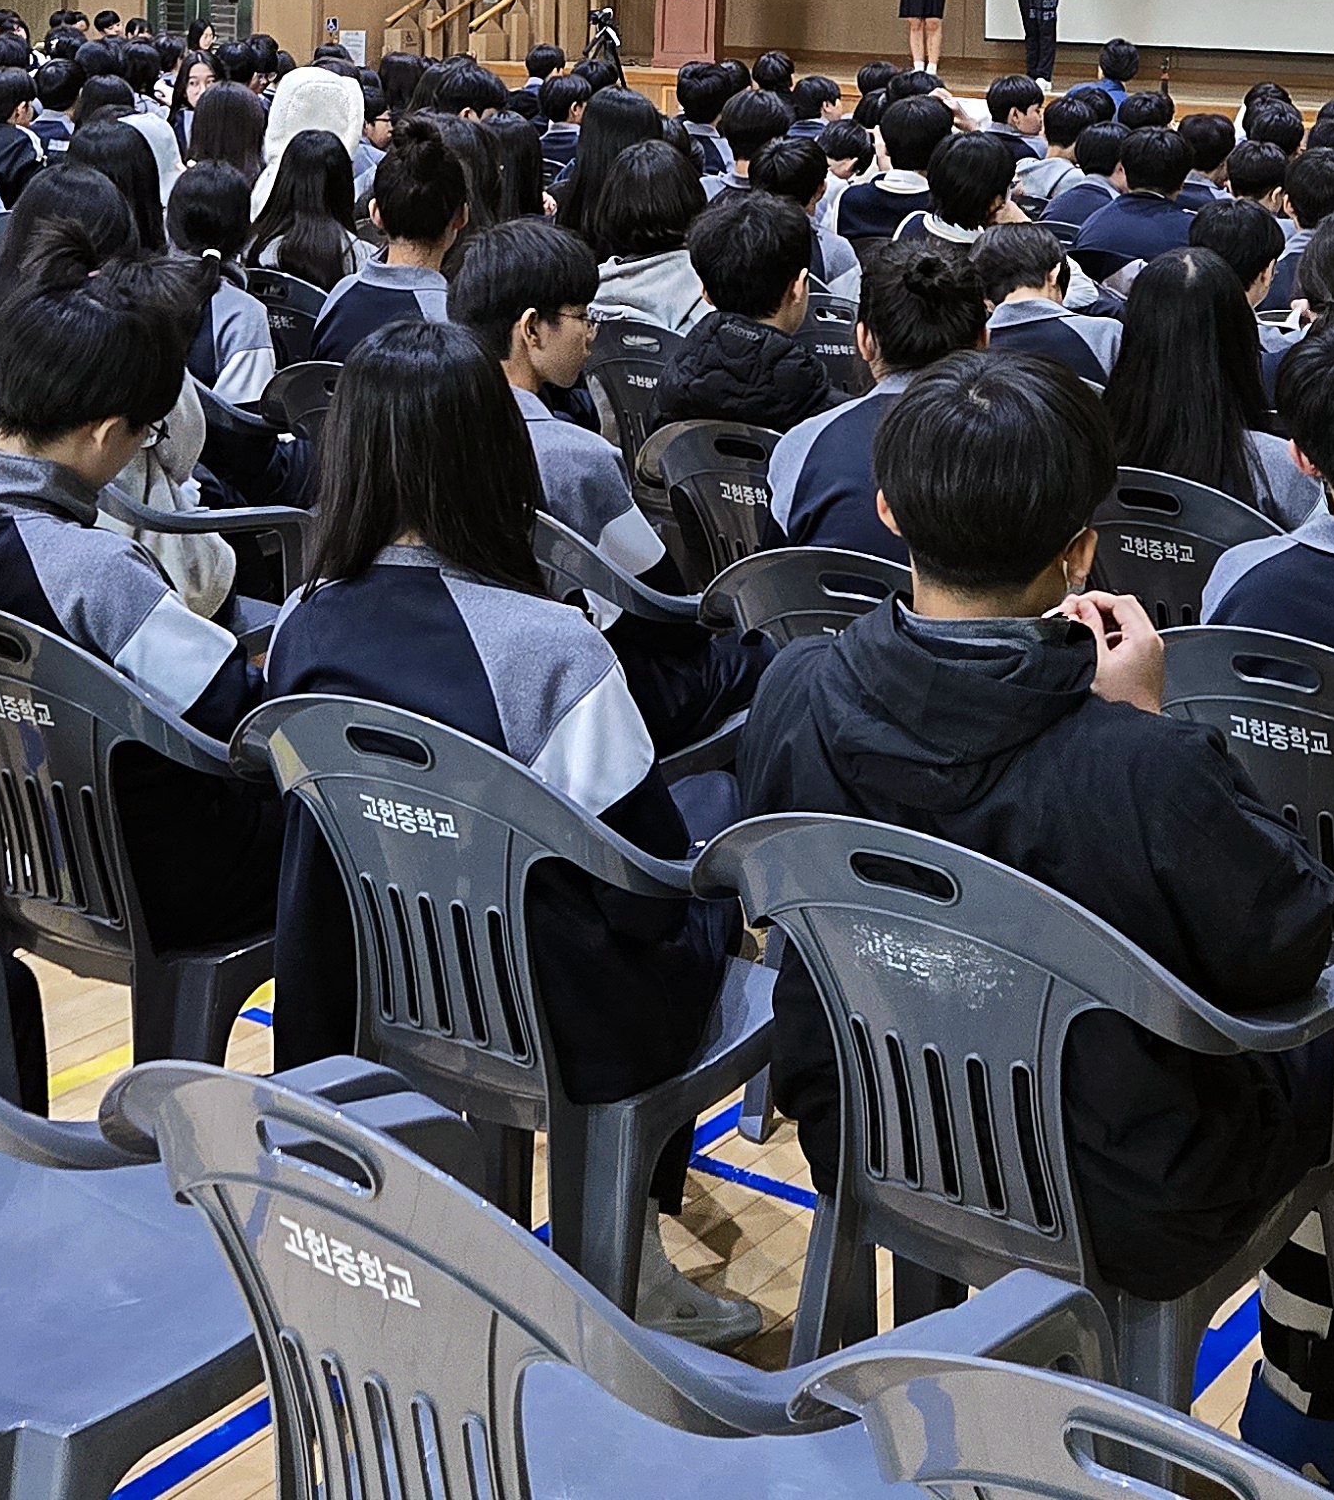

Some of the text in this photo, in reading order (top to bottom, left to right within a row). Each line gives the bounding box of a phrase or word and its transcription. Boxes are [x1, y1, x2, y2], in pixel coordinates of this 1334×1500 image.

[719, 481, 767, 508] 고헌중학
[1120, 534, 1195, 565] 고헌중학교
[1229, 713, 1332, 757] 고헌중학교
[358, 792, 460, 841] 고헌중학교
[279, 1214, 421, 1310] 고헌중학교
